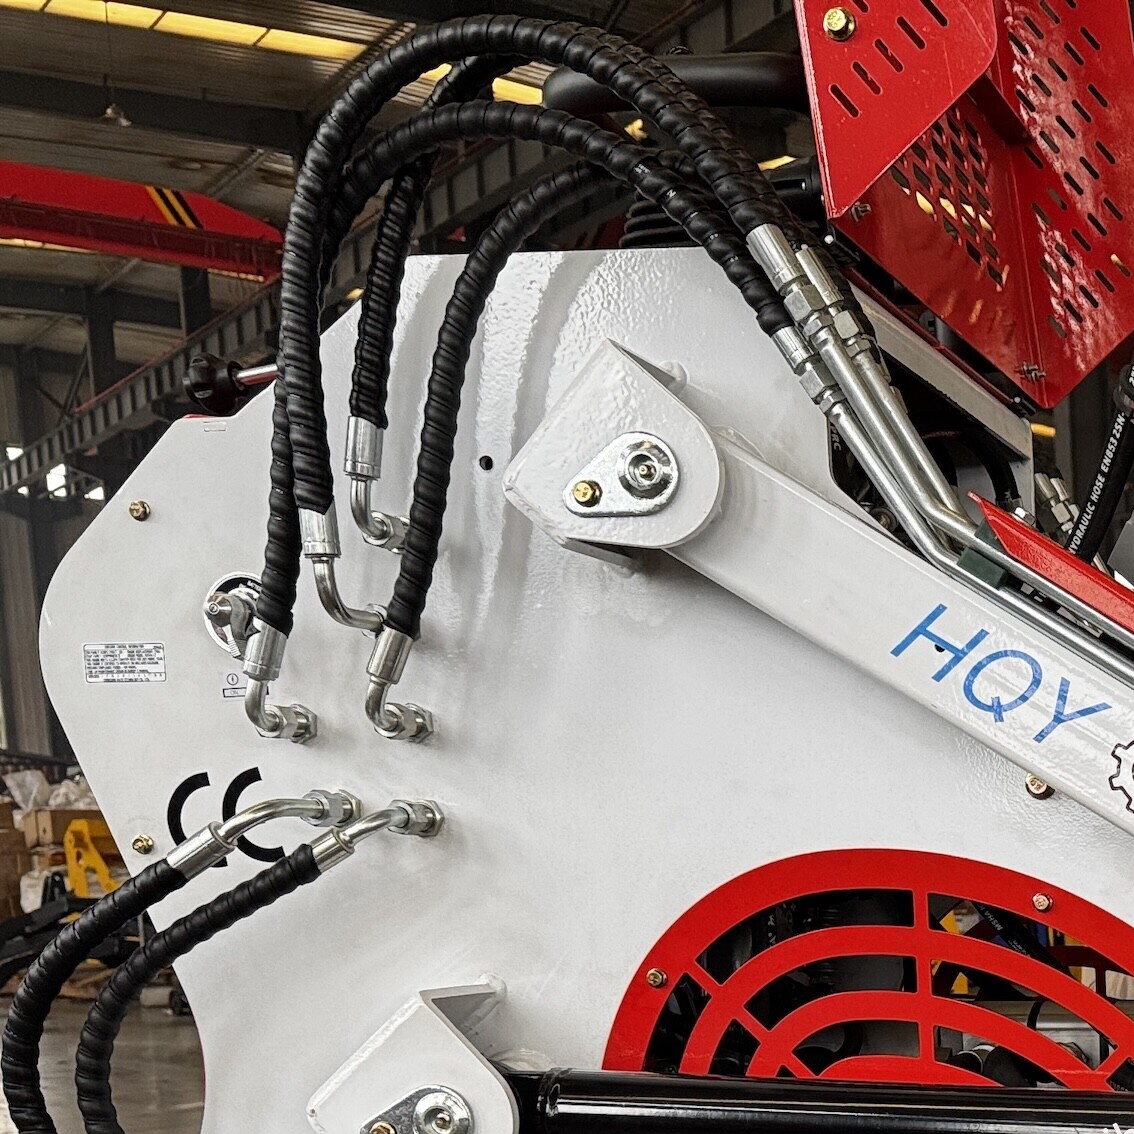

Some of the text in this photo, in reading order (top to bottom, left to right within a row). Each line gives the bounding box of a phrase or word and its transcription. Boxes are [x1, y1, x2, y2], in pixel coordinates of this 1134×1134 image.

[1090, 473, 1105, 503] HOSE
[1101, 436, 1118, 473] EN853
[890, 603, 1112, 744] HQY
